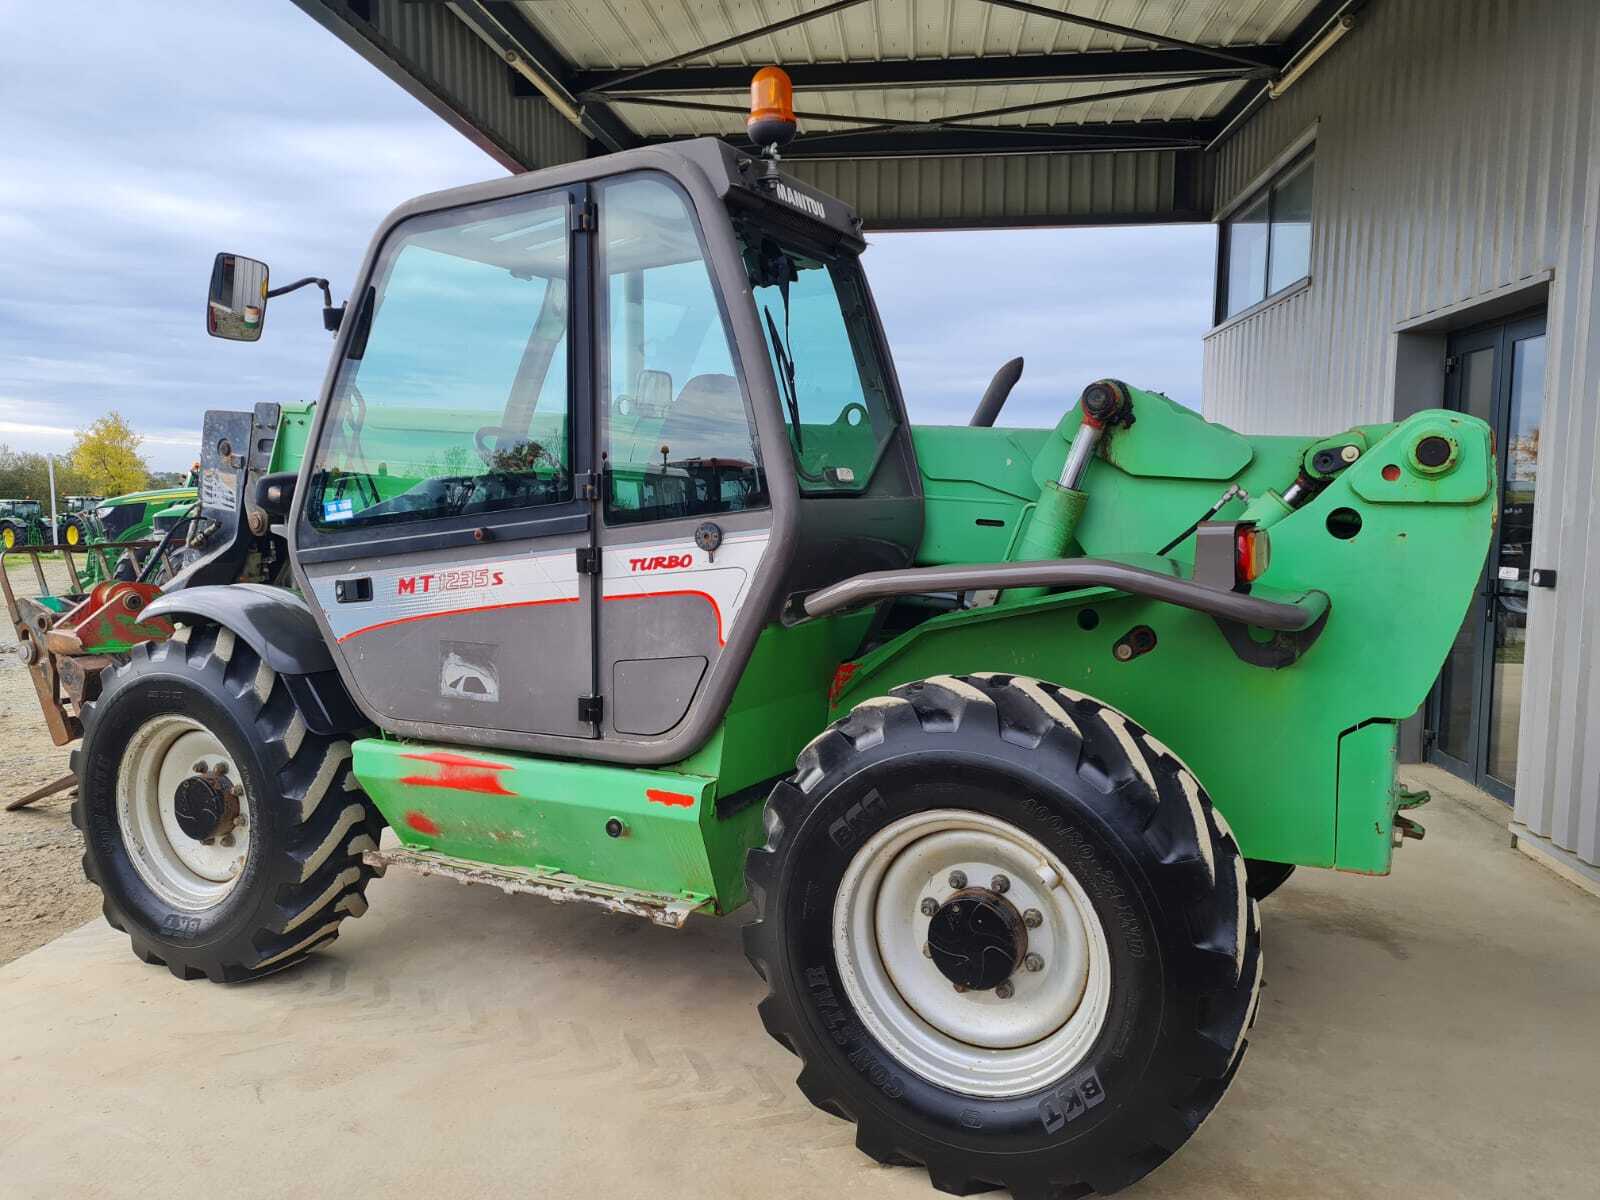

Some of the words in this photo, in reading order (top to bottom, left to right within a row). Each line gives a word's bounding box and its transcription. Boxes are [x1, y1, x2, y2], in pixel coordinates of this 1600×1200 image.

[776, 183, 826, 219] MANITOU
[629, 554, 693, 571] TURBO
[398, 574, 434, 595] MT
[829, 788, 888, 851] BKT
[1041, 1067, 1105, 1132] BKT
